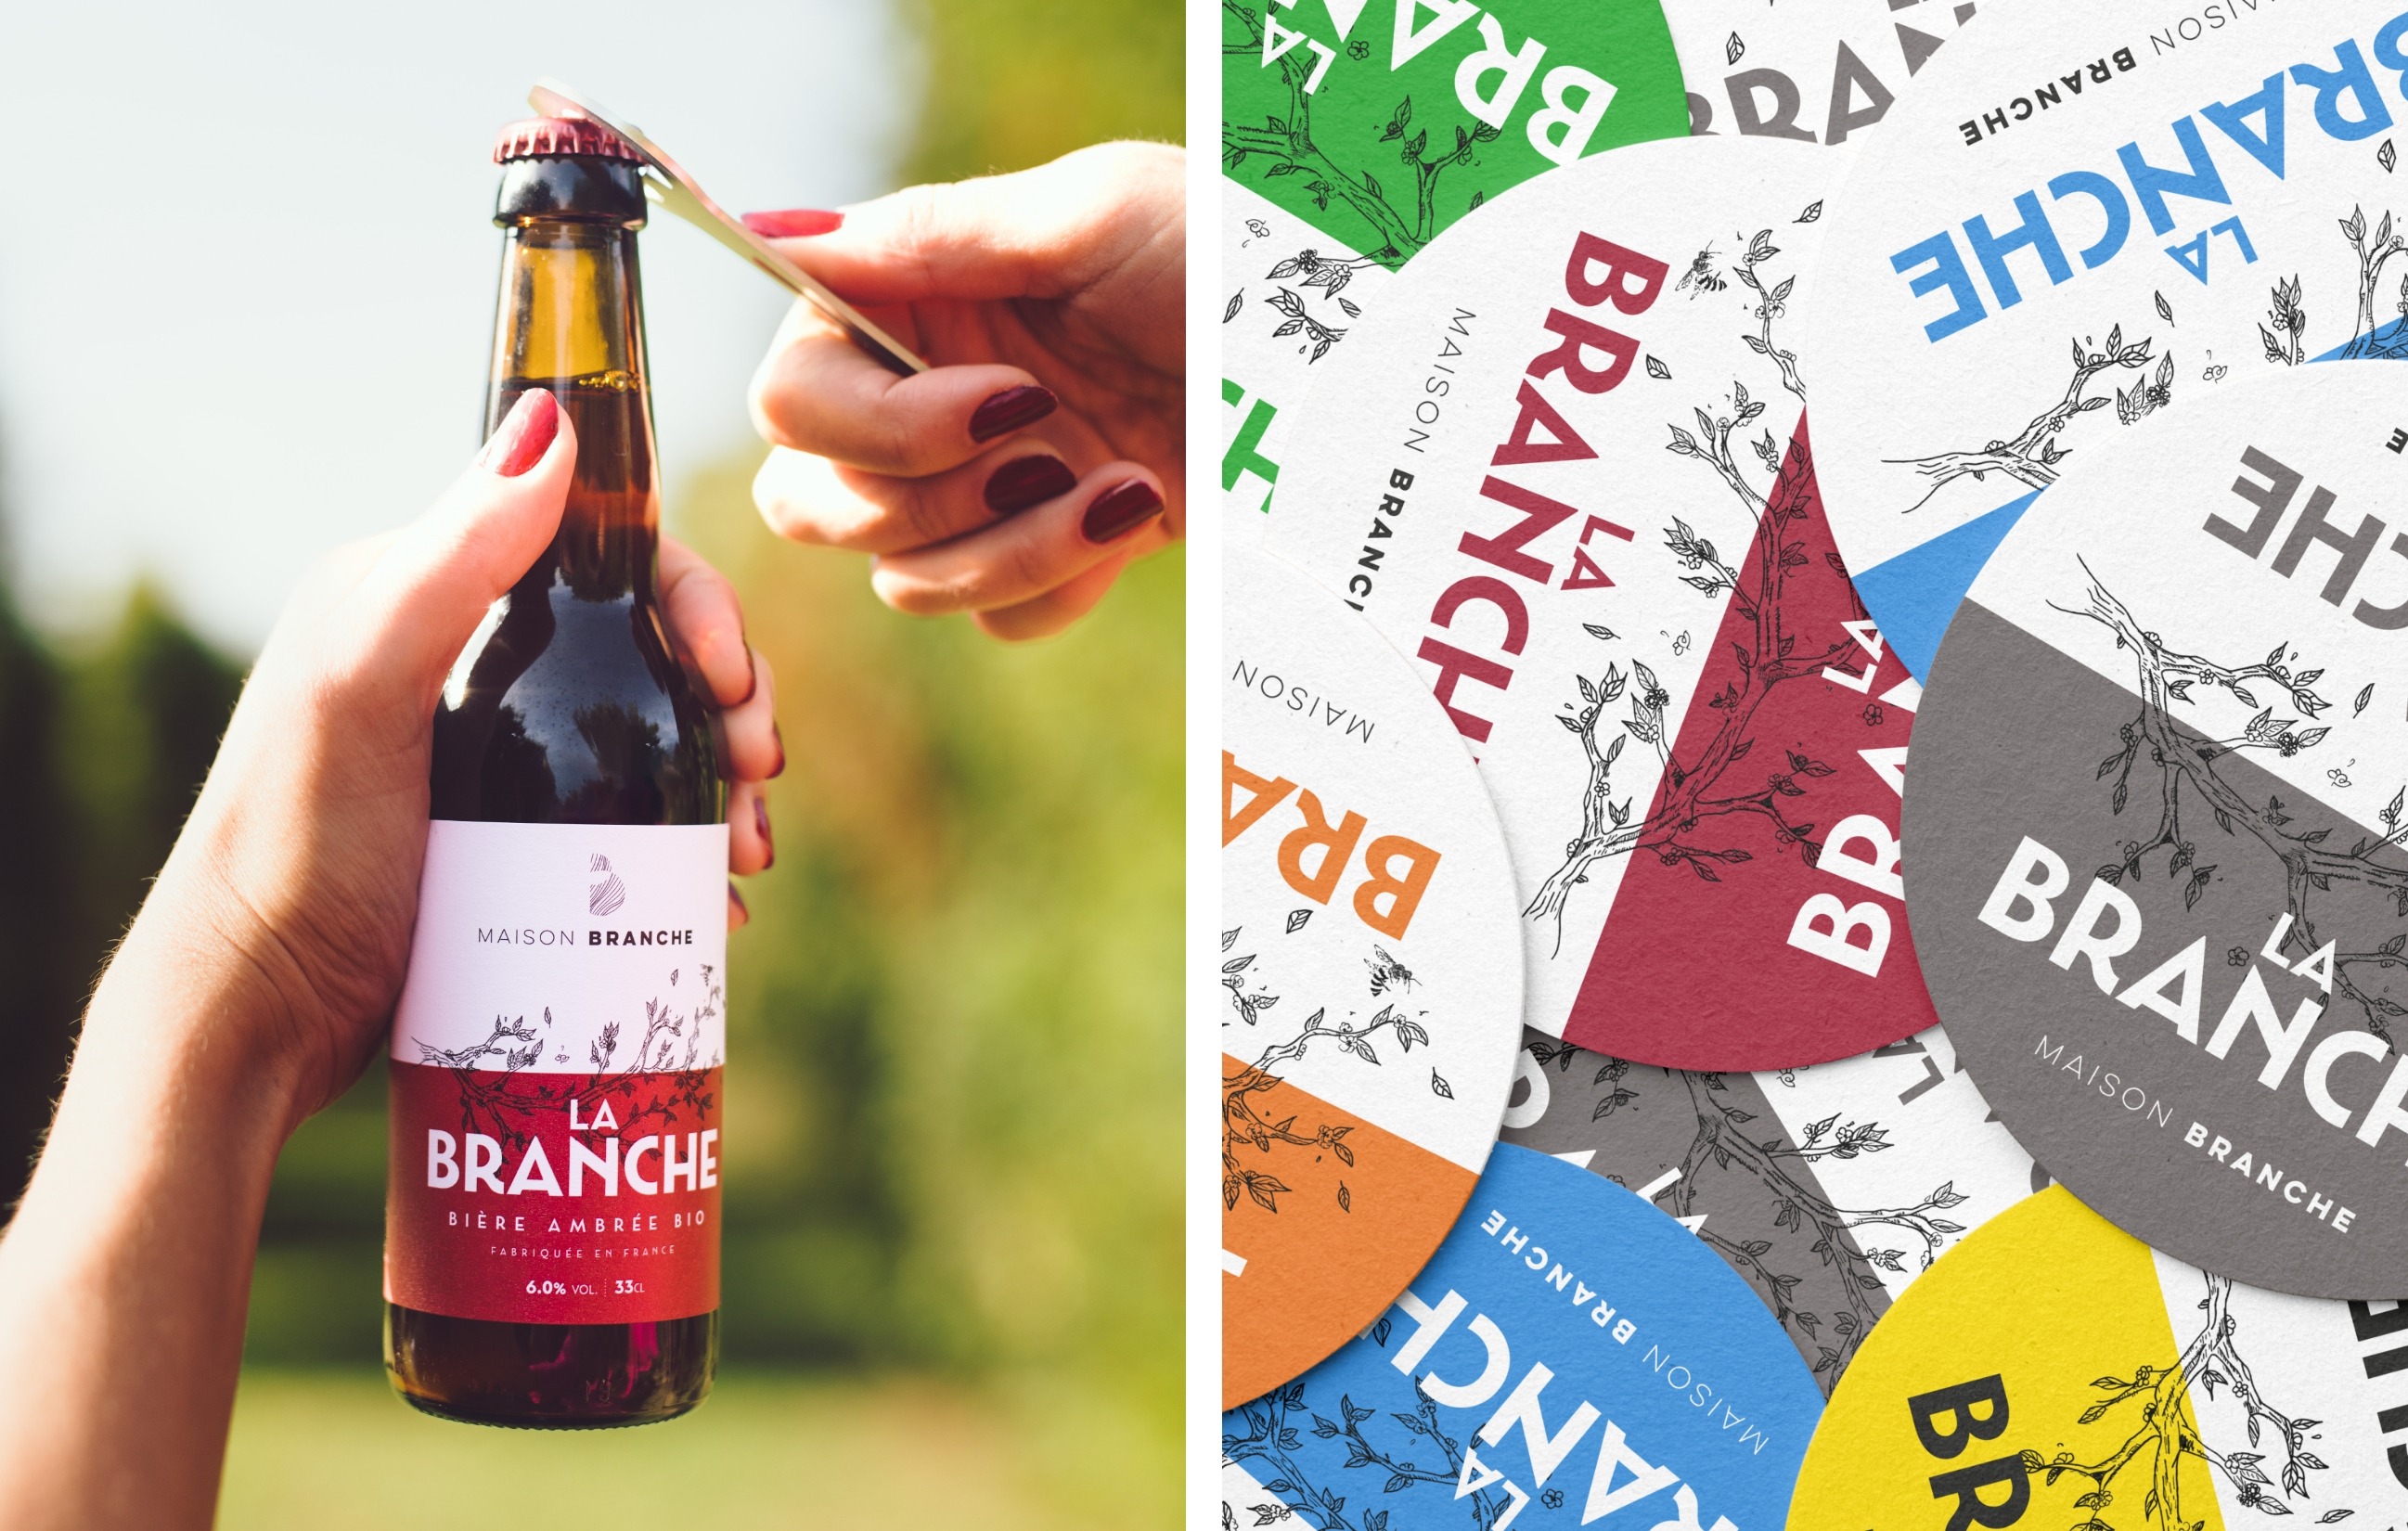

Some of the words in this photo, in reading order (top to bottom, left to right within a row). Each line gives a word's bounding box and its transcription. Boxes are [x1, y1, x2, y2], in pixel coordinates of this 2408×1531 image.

[1261, 13, 1336, 96] LA
[1273, 0, 1617, 166] BRA
[1959, 47, 2136, 147] BRANCHE
[2164, 214, 2259, 286] LA
[1403, 307, 1476, 453] MAISON
[1560, 514, 1635, 591] LA
[1821, 618, 1885, 694] LA
[1232, 660, 1374, 743] MAISON
[478, 927, 575, 946] MAISON
[588, 929, 693, 946] BRANCHE
[2260, 911, 2336, 995] LA
[570, 1099, 618, 1129] LA
[2034, 1035, 2173, 1128] MAISON
[2183, 1121, 2356, 1233] BRANCHE
[427, 1128, 718, 1197] BRANCHE
[449, 1211, 526, 1232] BIÈRE
[547, 1213, 659, 1234] AMBRÉE
[675, 1209, 705, 1227] BIO
[491, 1245, 584, 1259] FABRIQUÉE
[595, 1249, 612, 1258] EN
[623, 1244, 675, 1256] FRANCE
[526, 1280, 566, 1296] 6.0%
[572, 1284, 598, 1295] VOL.
[1481, 1210, 1637, 1344] BRANCHE
[1642, 1344, 1770, 1455] MAISON
